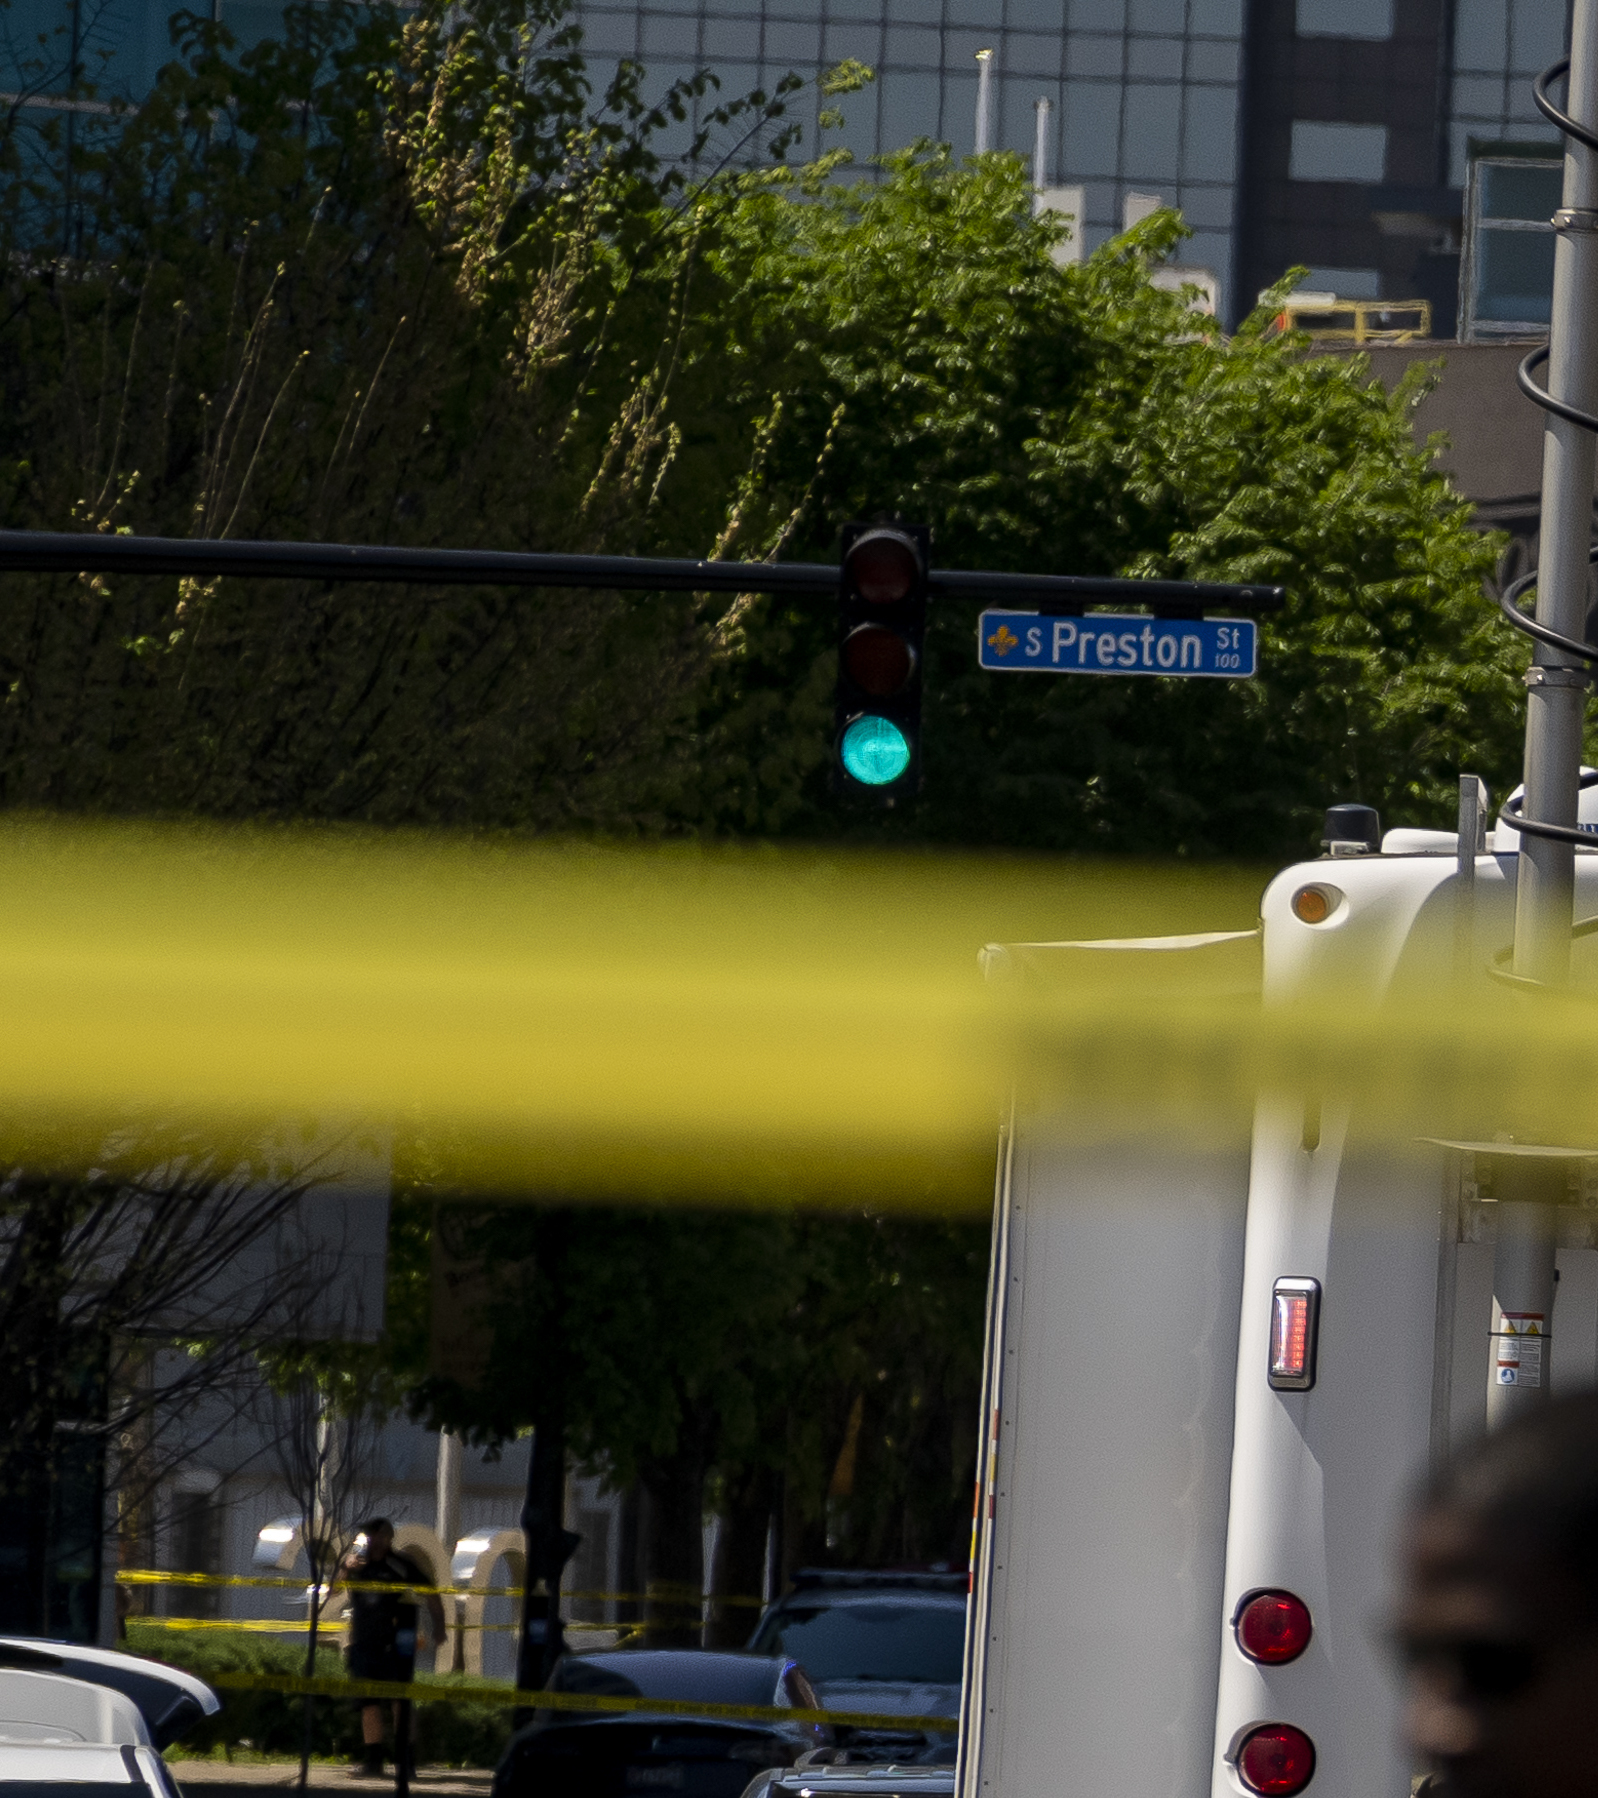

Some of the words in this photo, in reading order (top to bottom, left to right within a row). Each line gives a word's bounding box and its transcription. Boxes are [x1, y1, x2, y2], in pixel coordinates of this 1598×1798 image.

[1025, 627, 1042, 657] S
[1052, 621, 1202, 669] Preston
[1217, 626, 1240, 650] St
[1214, 652, 1240, 669] 100
